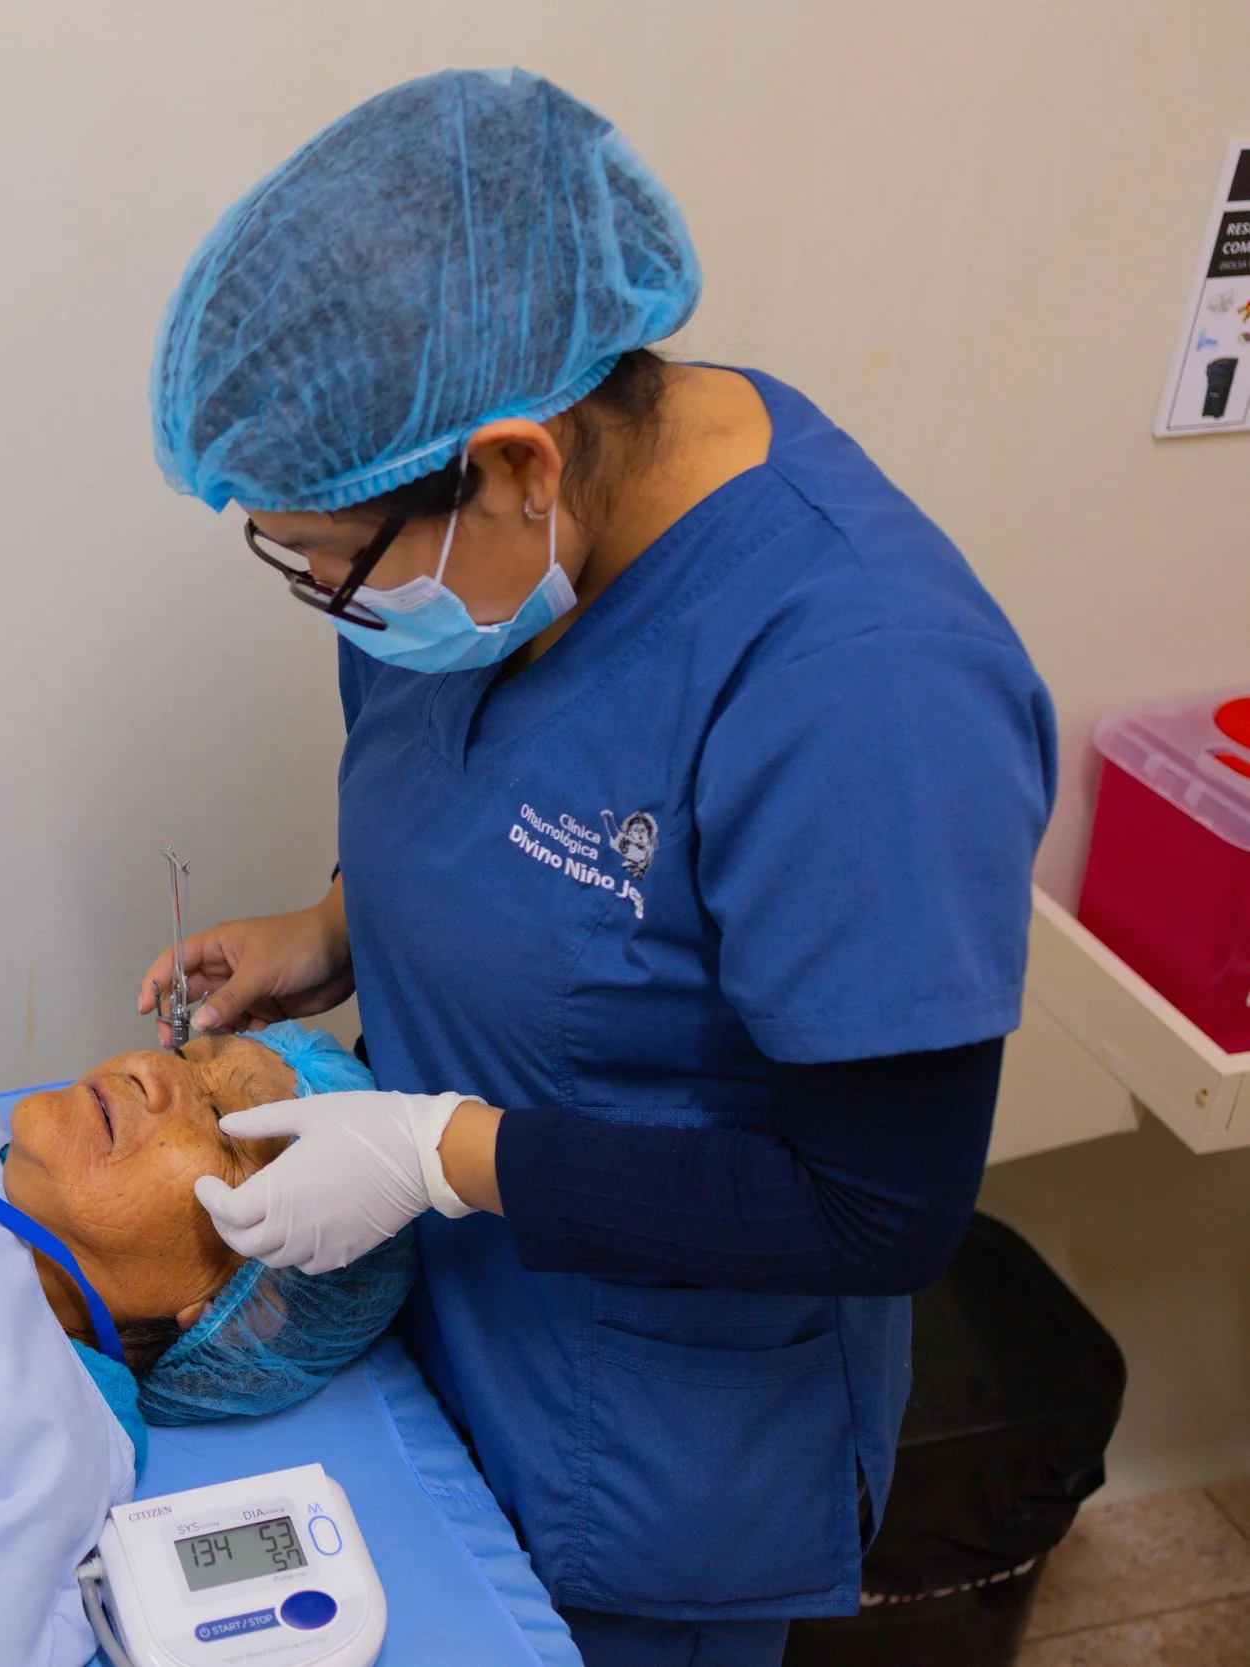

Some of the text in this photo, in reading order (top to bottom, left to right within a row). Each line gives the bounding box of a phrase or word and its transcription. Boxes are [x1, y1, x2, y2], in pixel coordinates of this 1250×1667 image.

[1226, 222, 1250, 236] RES
[520, 803, 598, 860] Oftalmológica
[559, 814, 601, 844] Clínica
[509, 824, 563, 868] Divino
[564, 857, 615, 891] Niño
[128, 1505, 172, 1522] CITIZEN
[243, 1508, 265, 1520] DIA
[307, 1503, 323, 1515] M
[177, 1521, 200, 1535] SYS
[258, 1522, 295, 1553] 53
[190, 1536, 233, 1567] 134
[211, 1621, 241, 1635] START
[248, 1614, 273, 1627] STOP
